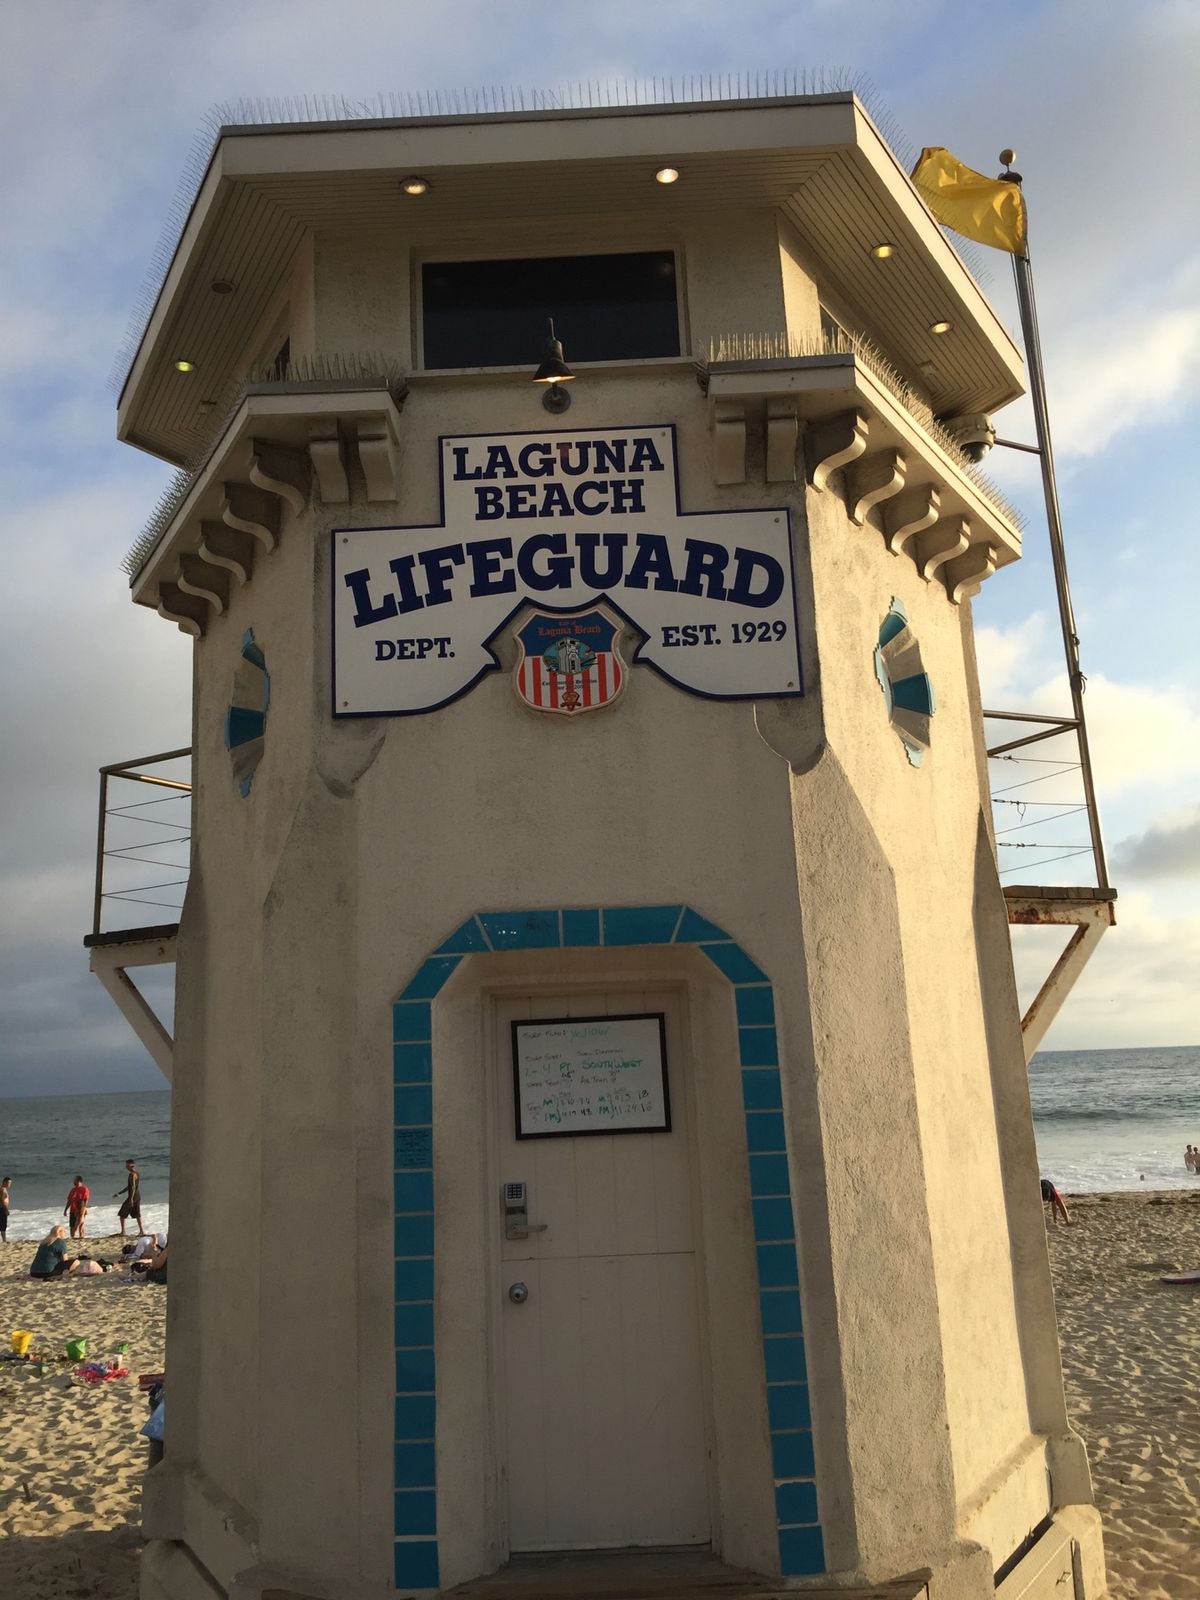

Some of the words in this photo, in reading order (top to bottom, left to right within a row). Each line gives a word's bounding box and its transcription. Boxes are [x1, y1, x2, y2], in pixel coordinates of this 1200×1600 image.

[453, 437, 665, 481] LAGUNA
[475, 478, 646, 520] BEACH
[344, 533, 785, 628] LIFEGUARD
[538, 626, 571, 636] Laguna
[575, 625, 601, 634] Beach
[661, 623, 722, 647] EST.
[731, 620, 788, 643] 1929
[375, 637, 455, 661] DEPT.
